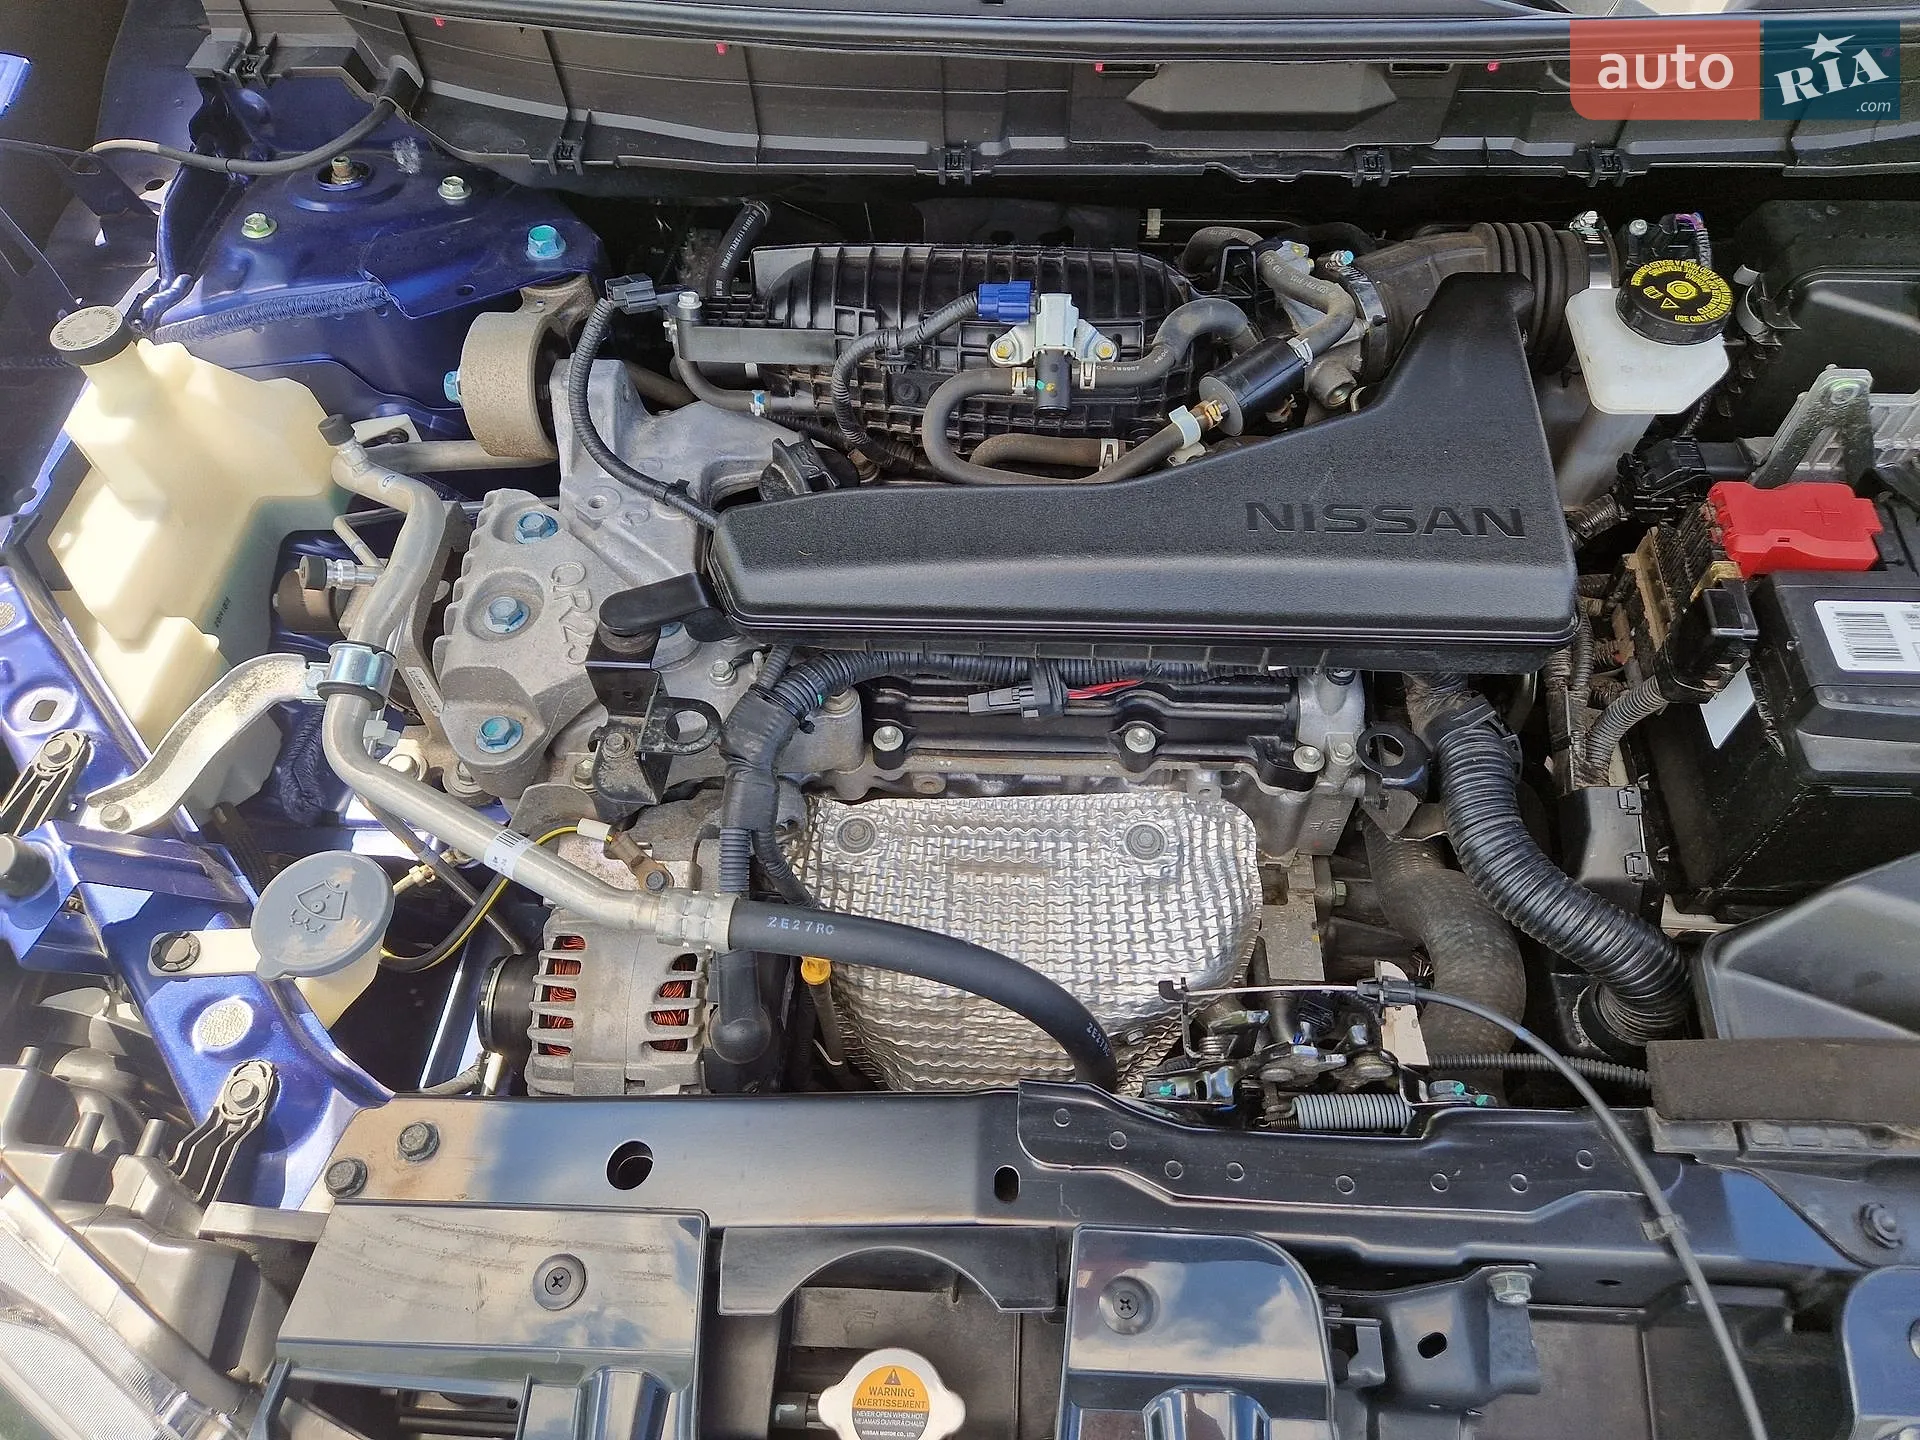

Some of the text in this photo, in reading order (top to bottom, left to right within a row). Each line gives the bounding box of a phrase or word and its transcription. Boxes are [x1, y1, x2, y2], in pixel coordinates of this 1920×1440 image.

[1648, 259, 1675, 269] SEALED
[1682, 260, 1701, 270] FROM
[1630, 264, 1652, 286] CONTAINER
[1682, 265, 1712, 281] BEFORE
[1699, 267, 1720, 280] FLUID
[1710, 289, 1722, 304] FILLER
[1696, 301, 1718, 314] CLEAN
[1246, 502, 1526, 538] NISSAN
[868, 1386, 916, 1398] WARNING
[856, 1398, 926, 1409] AVERTISSEMENT
